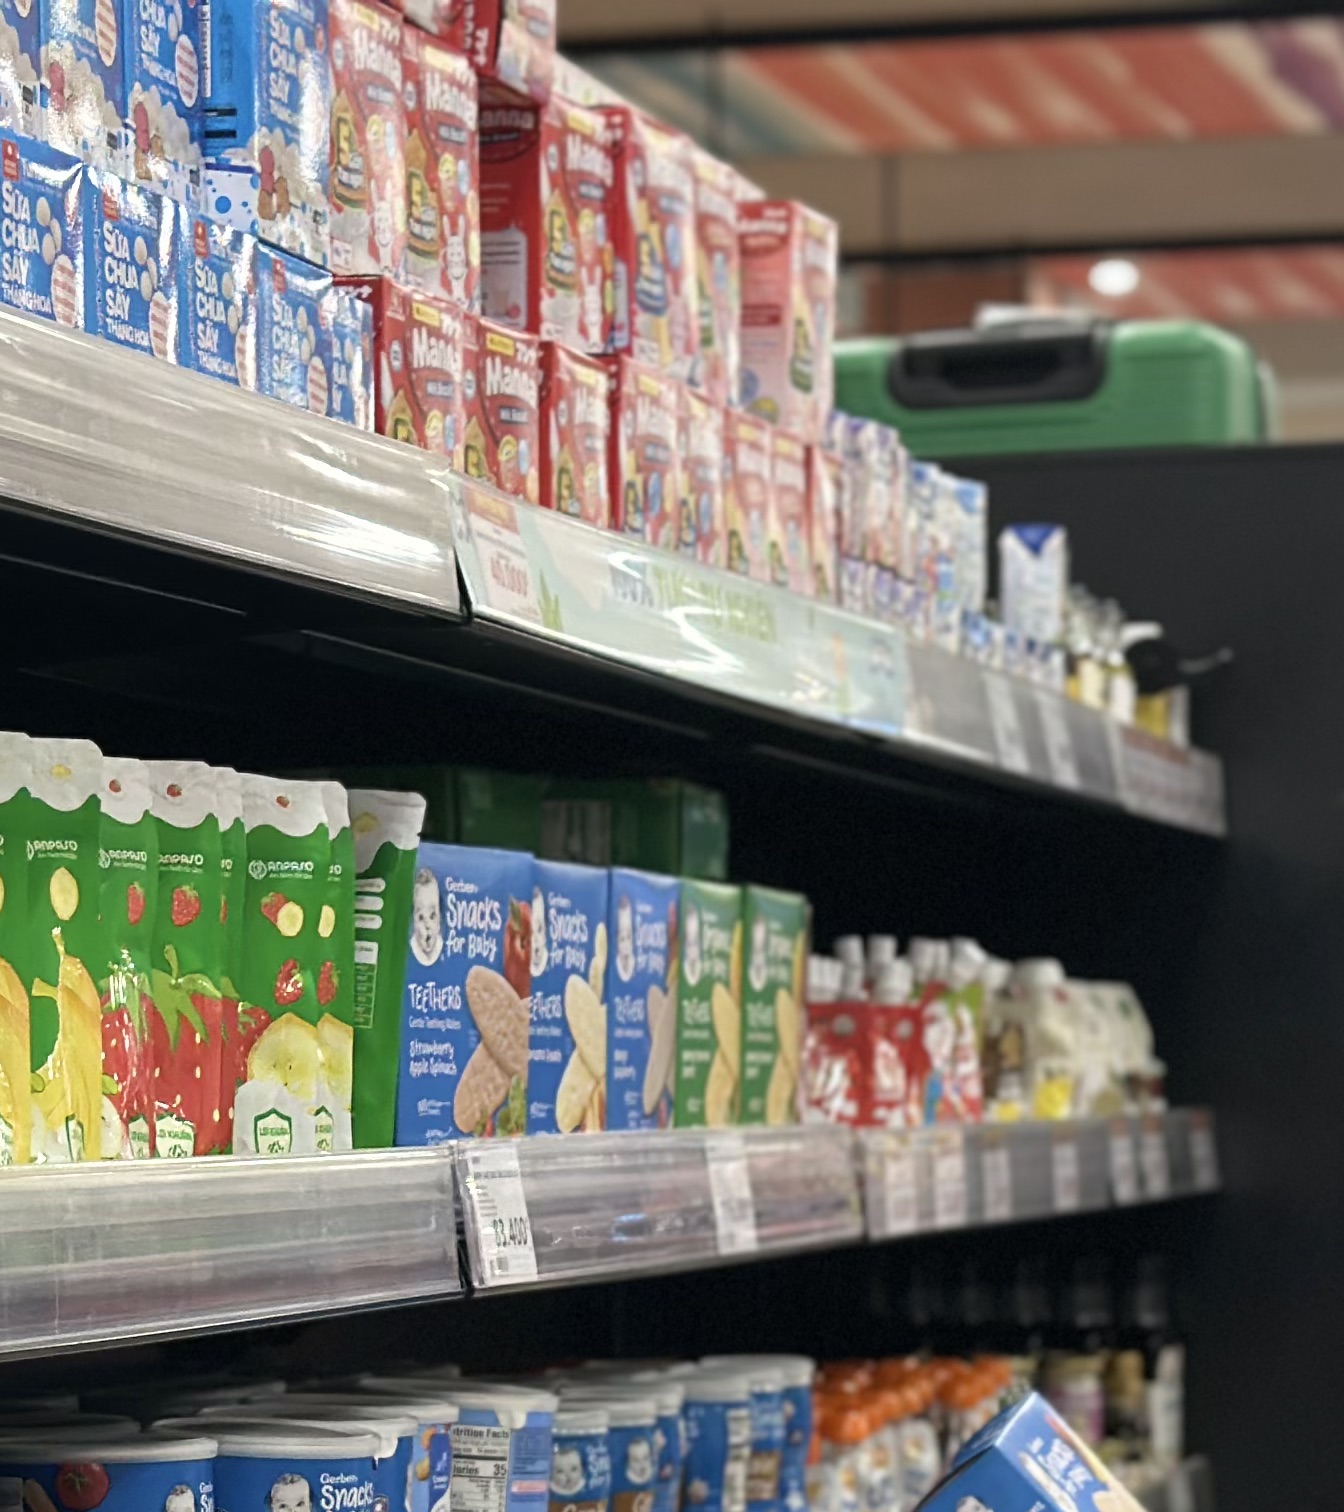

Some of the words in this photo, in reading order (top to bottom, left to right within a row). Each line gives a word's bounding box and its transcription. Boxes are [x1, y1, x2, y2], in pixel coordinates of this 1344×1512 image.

[479, 109, 535, 129] anna
[1, 181, 30, 222] SỮA
[2, 218, 39, 253] CHUA
[105, 256, 138, 290] CHUA
[446, 894, 502, 930] Snacks
[549, 908, 588, 942] Snacks
[446, 931, 466, 953] for
[468, 934, 496, 964] Baby
[408, 982, 462, 1012] TEETHERS
[410, 1039, 454, 1058] Strawberry
[320, 1473, 356, 1485] Gerber
[321, 1482, 374, 1511] Snacks
